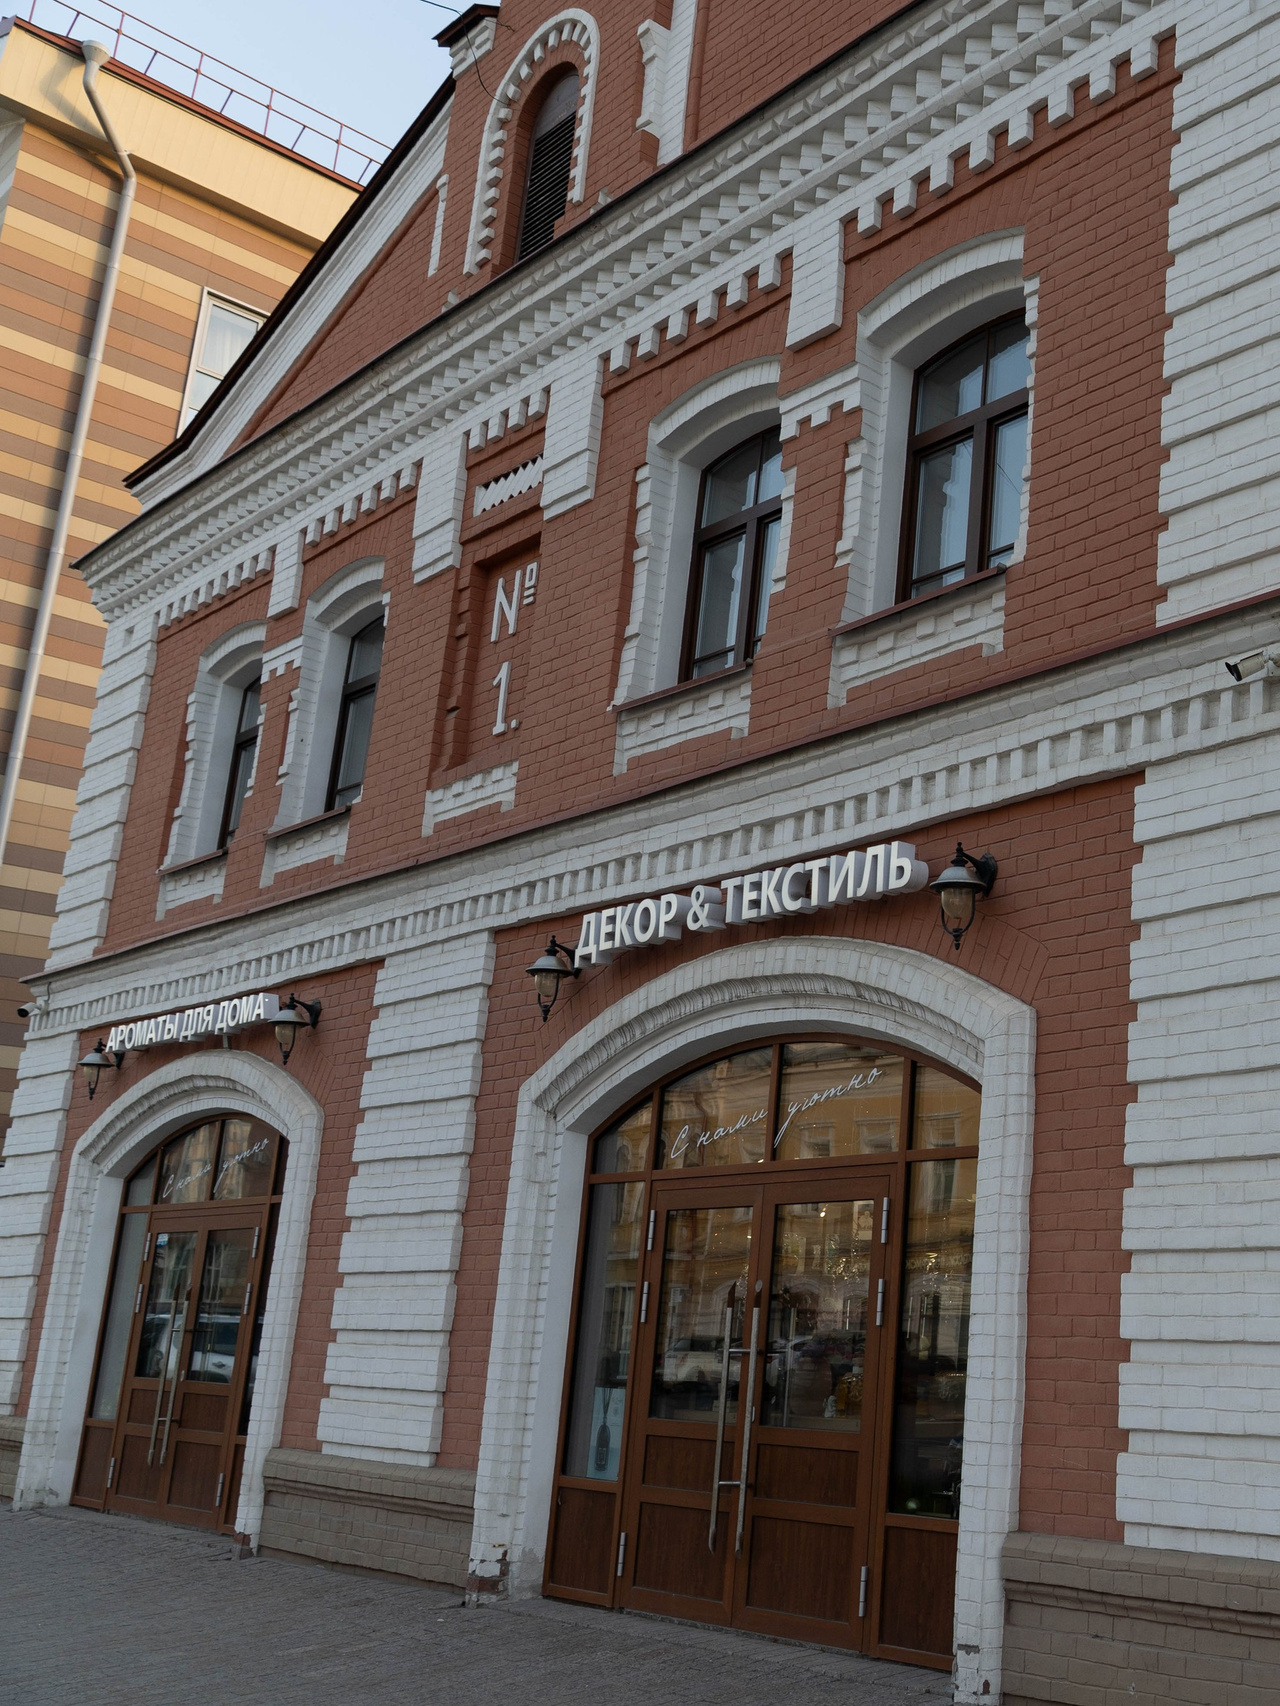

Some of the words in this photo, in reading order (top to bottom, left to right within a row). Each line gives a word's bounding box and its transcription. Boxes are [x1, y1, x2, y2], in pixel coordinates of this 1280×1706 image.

[574, 893, 681, 969] ДЕКОР
[687, 885, 718, 932] &
[721, 840, 920, 926] ТЕКСТИЛЬ
[105, 1013, 180, 1053] АРОМАТЫ
[179, 1003, 214, 1042] ДЛЯ
[215, 992, 266, 1035] ДОМА
[670, 1124, 690, 1159] С
[696, 1108, 769, 1148] нами
[773, 1066, 882, 1149] уютно
